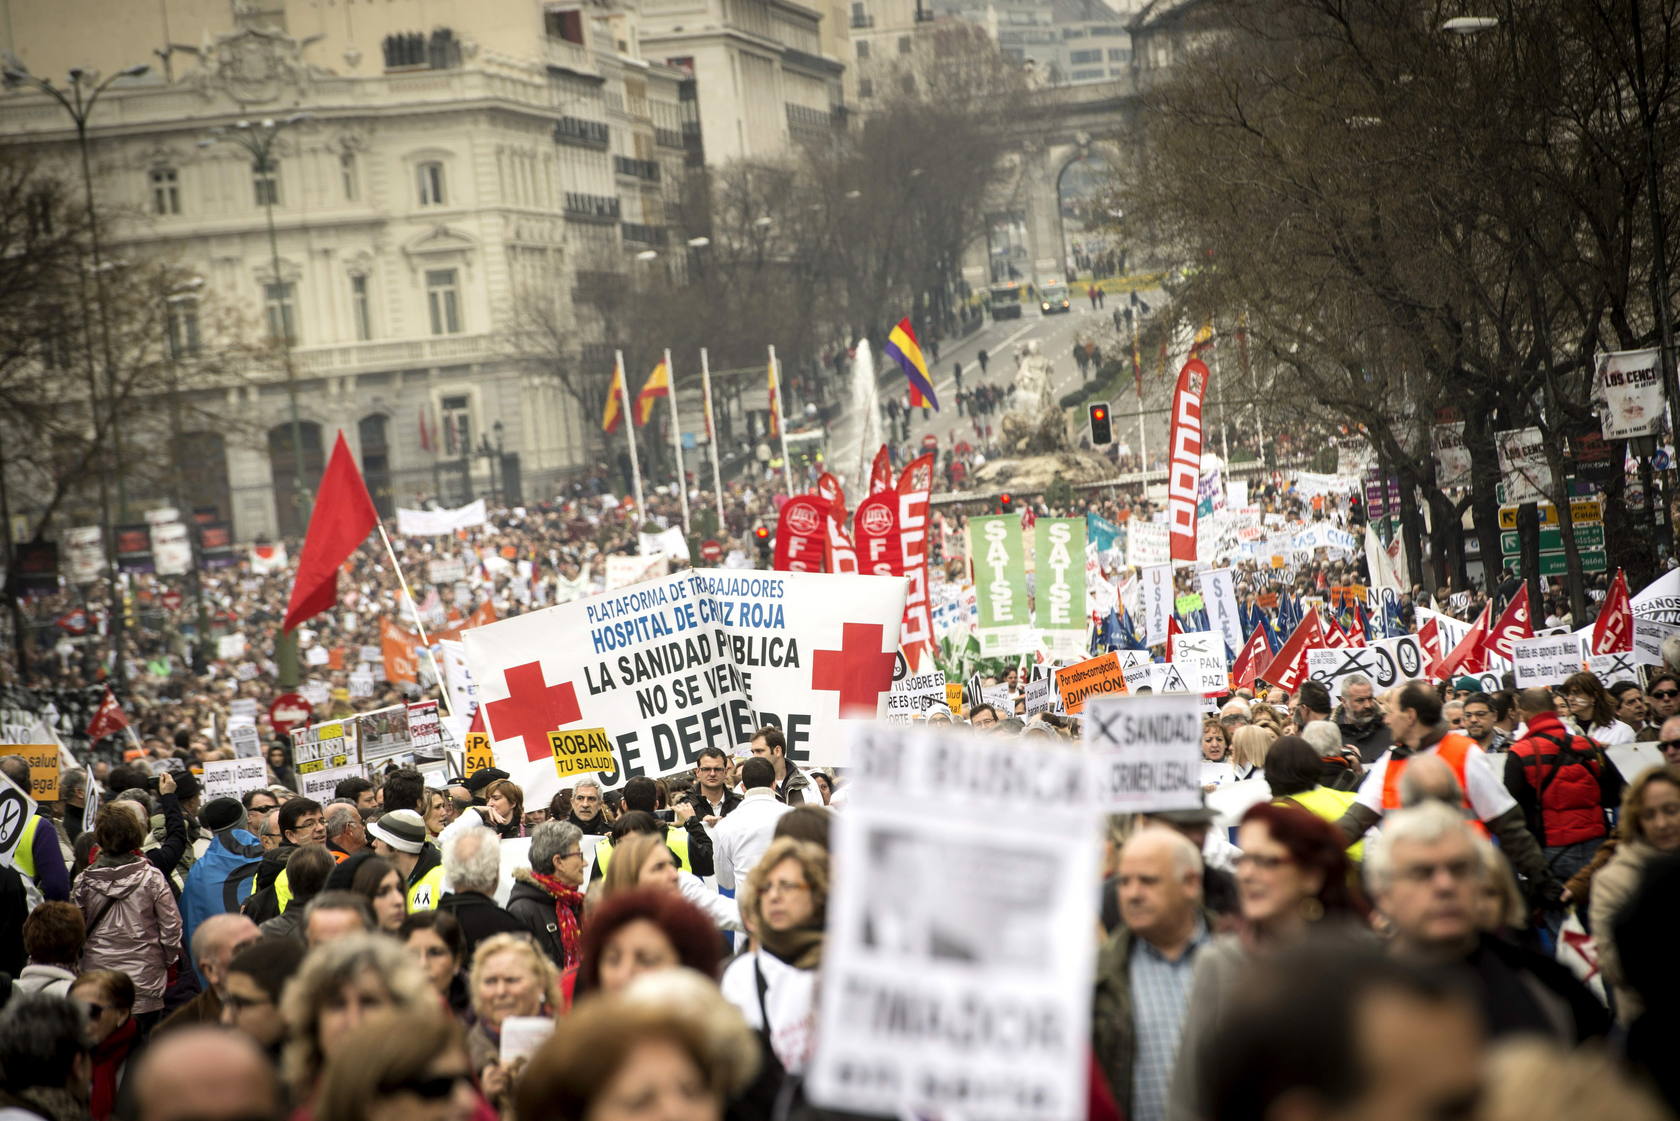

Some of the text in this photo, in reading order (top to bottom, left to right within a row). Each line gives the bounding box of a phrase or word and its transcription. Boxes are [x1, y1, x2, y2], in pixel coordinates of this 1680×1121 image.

[1604, 367, 1656, 388] LOS CENCI
[587, 575, 784, 624] PLATAFORMA DE TRABAJADORES
[591, 611, 673, 654] HOSPITAL
[674, 603, 698, 632] DE
[739, 602, 785, 629] ROJA
[584, 662, 616, 696] LA
[617, 633, 711, 686] SANIDAD
[905, 675, 933, 692] SOBRE
[934, 672, 945, 686] ES
[1060, 674, 1071, 686] Por
[636, 663, 753, 719] NO SE VENE
[899, 694, 909, 708] ES
[551, 733, 610, 757] ROBAN
[29, 753, 58, 768] salud
[557, 759, 576, 773] TU
